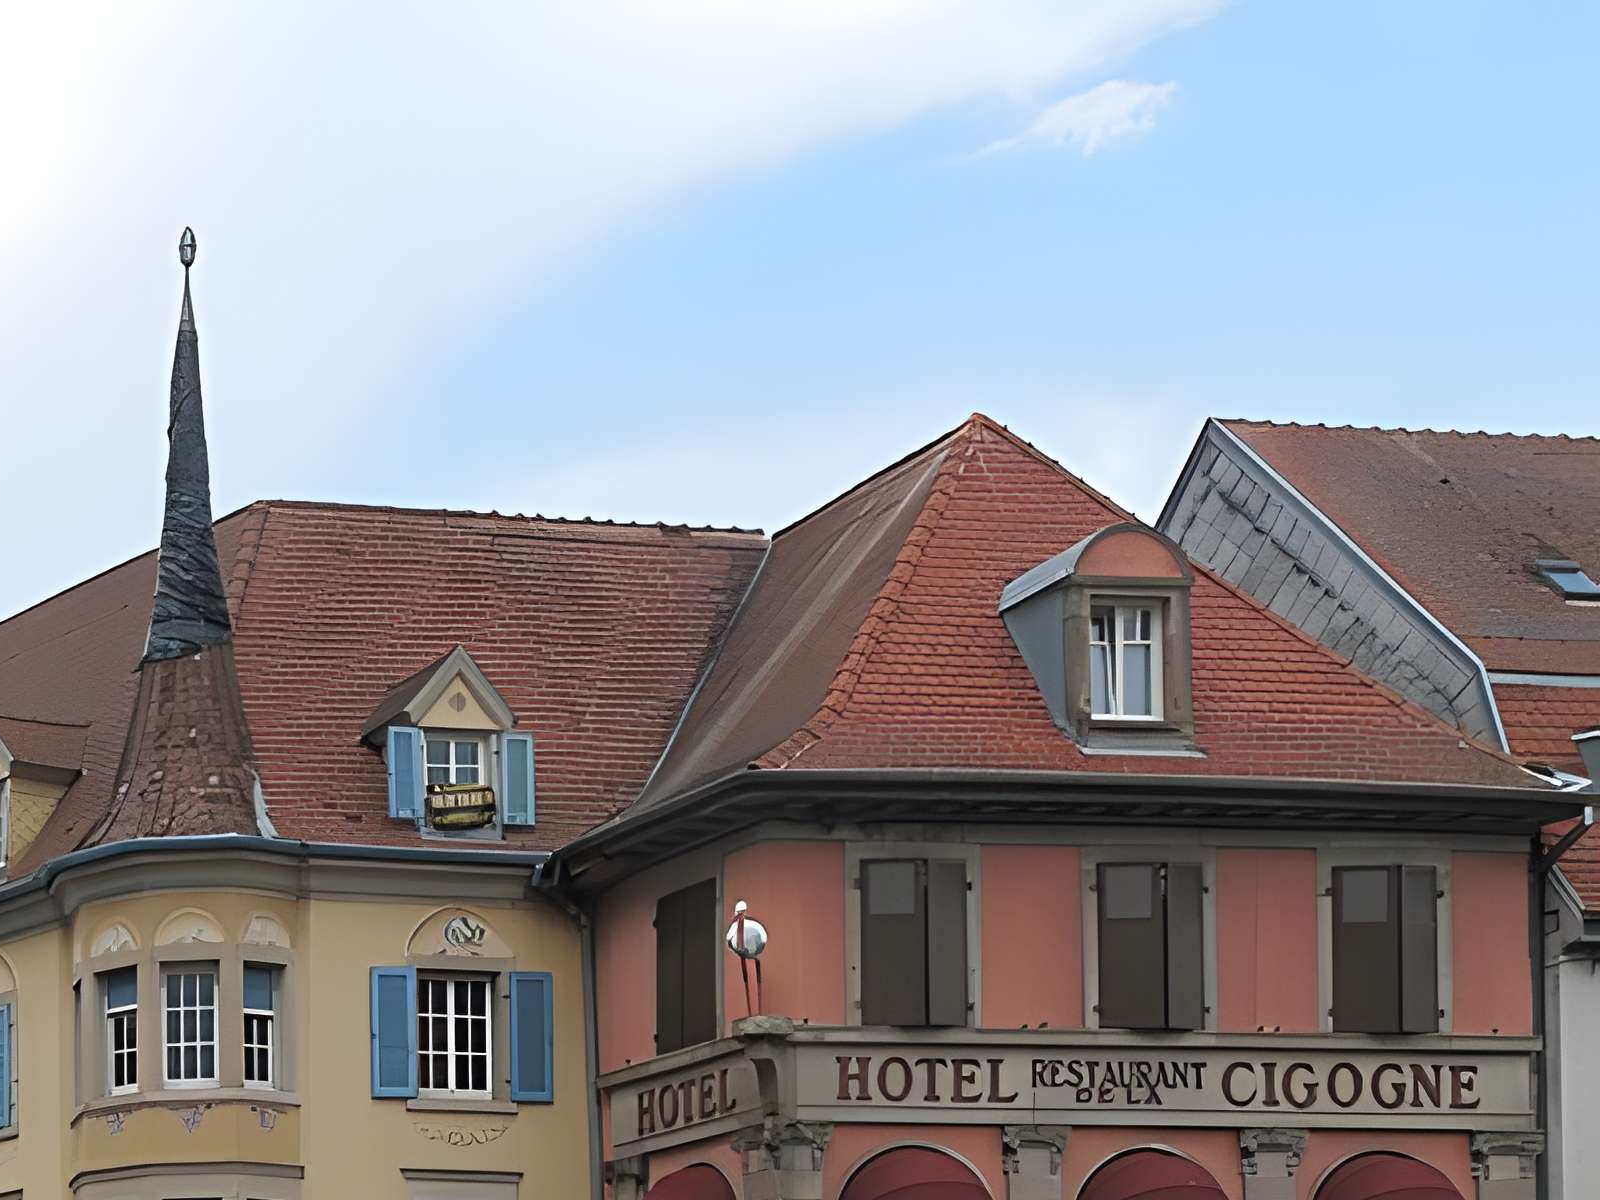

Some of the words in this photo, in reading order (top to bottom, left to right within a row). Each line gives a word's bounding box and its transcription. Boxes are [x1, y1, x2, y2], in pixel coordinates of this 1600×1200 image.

[835, 1056, 1019, 1103] HOTEL
[1031, 1058, 1207, 1090] RESTAURANT
[1221, 1061, 1481, 1109] CIGOGNE
[637, 1069, 737, 1137] HOTEL
